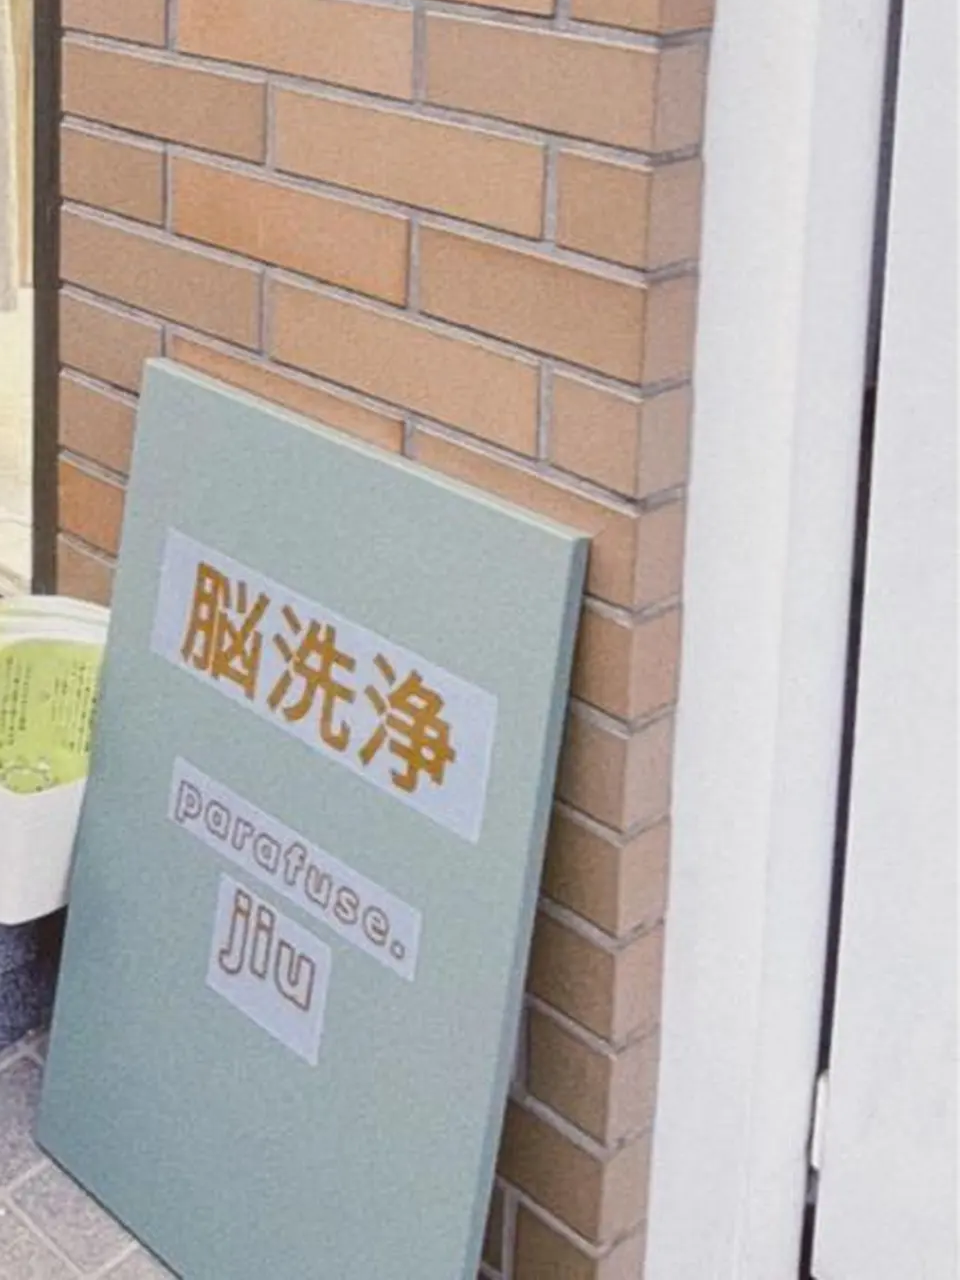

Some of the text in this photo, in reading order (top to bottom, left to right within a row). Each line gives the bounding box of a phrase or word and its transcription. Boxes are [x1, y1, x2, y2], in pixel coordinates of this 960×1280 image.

[180, 561, 456, 793] 脳洗浄
[174, 779, 406, 961] parafuse.
[218, 889, 316, 1012] jiu
